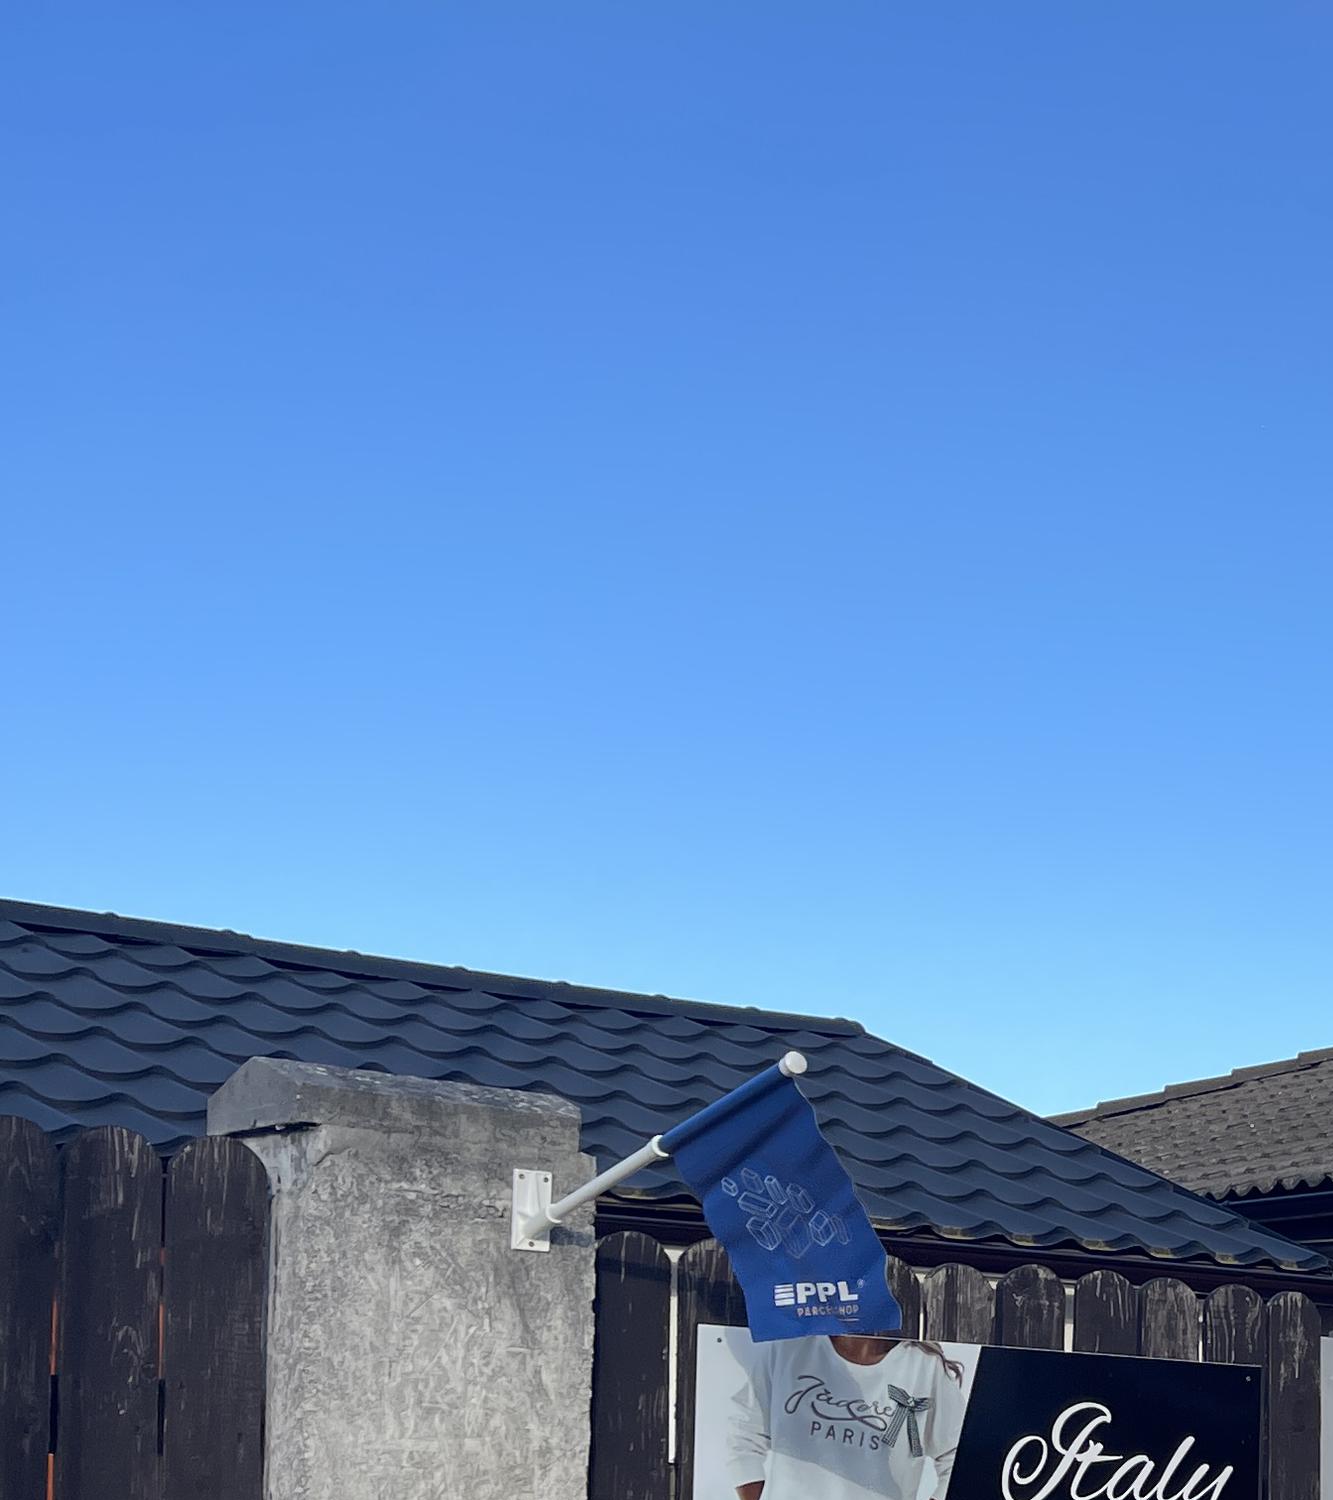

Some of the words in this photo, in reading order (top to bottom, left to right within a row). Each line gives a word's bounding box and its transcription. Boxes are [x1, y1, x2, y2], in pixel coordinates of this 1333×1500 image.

[795, 1280, 859, 1305] PPL
[796, 1304, 860, 1317] PARCEHOP
[810, 1421, 882, 1451] PARIS
